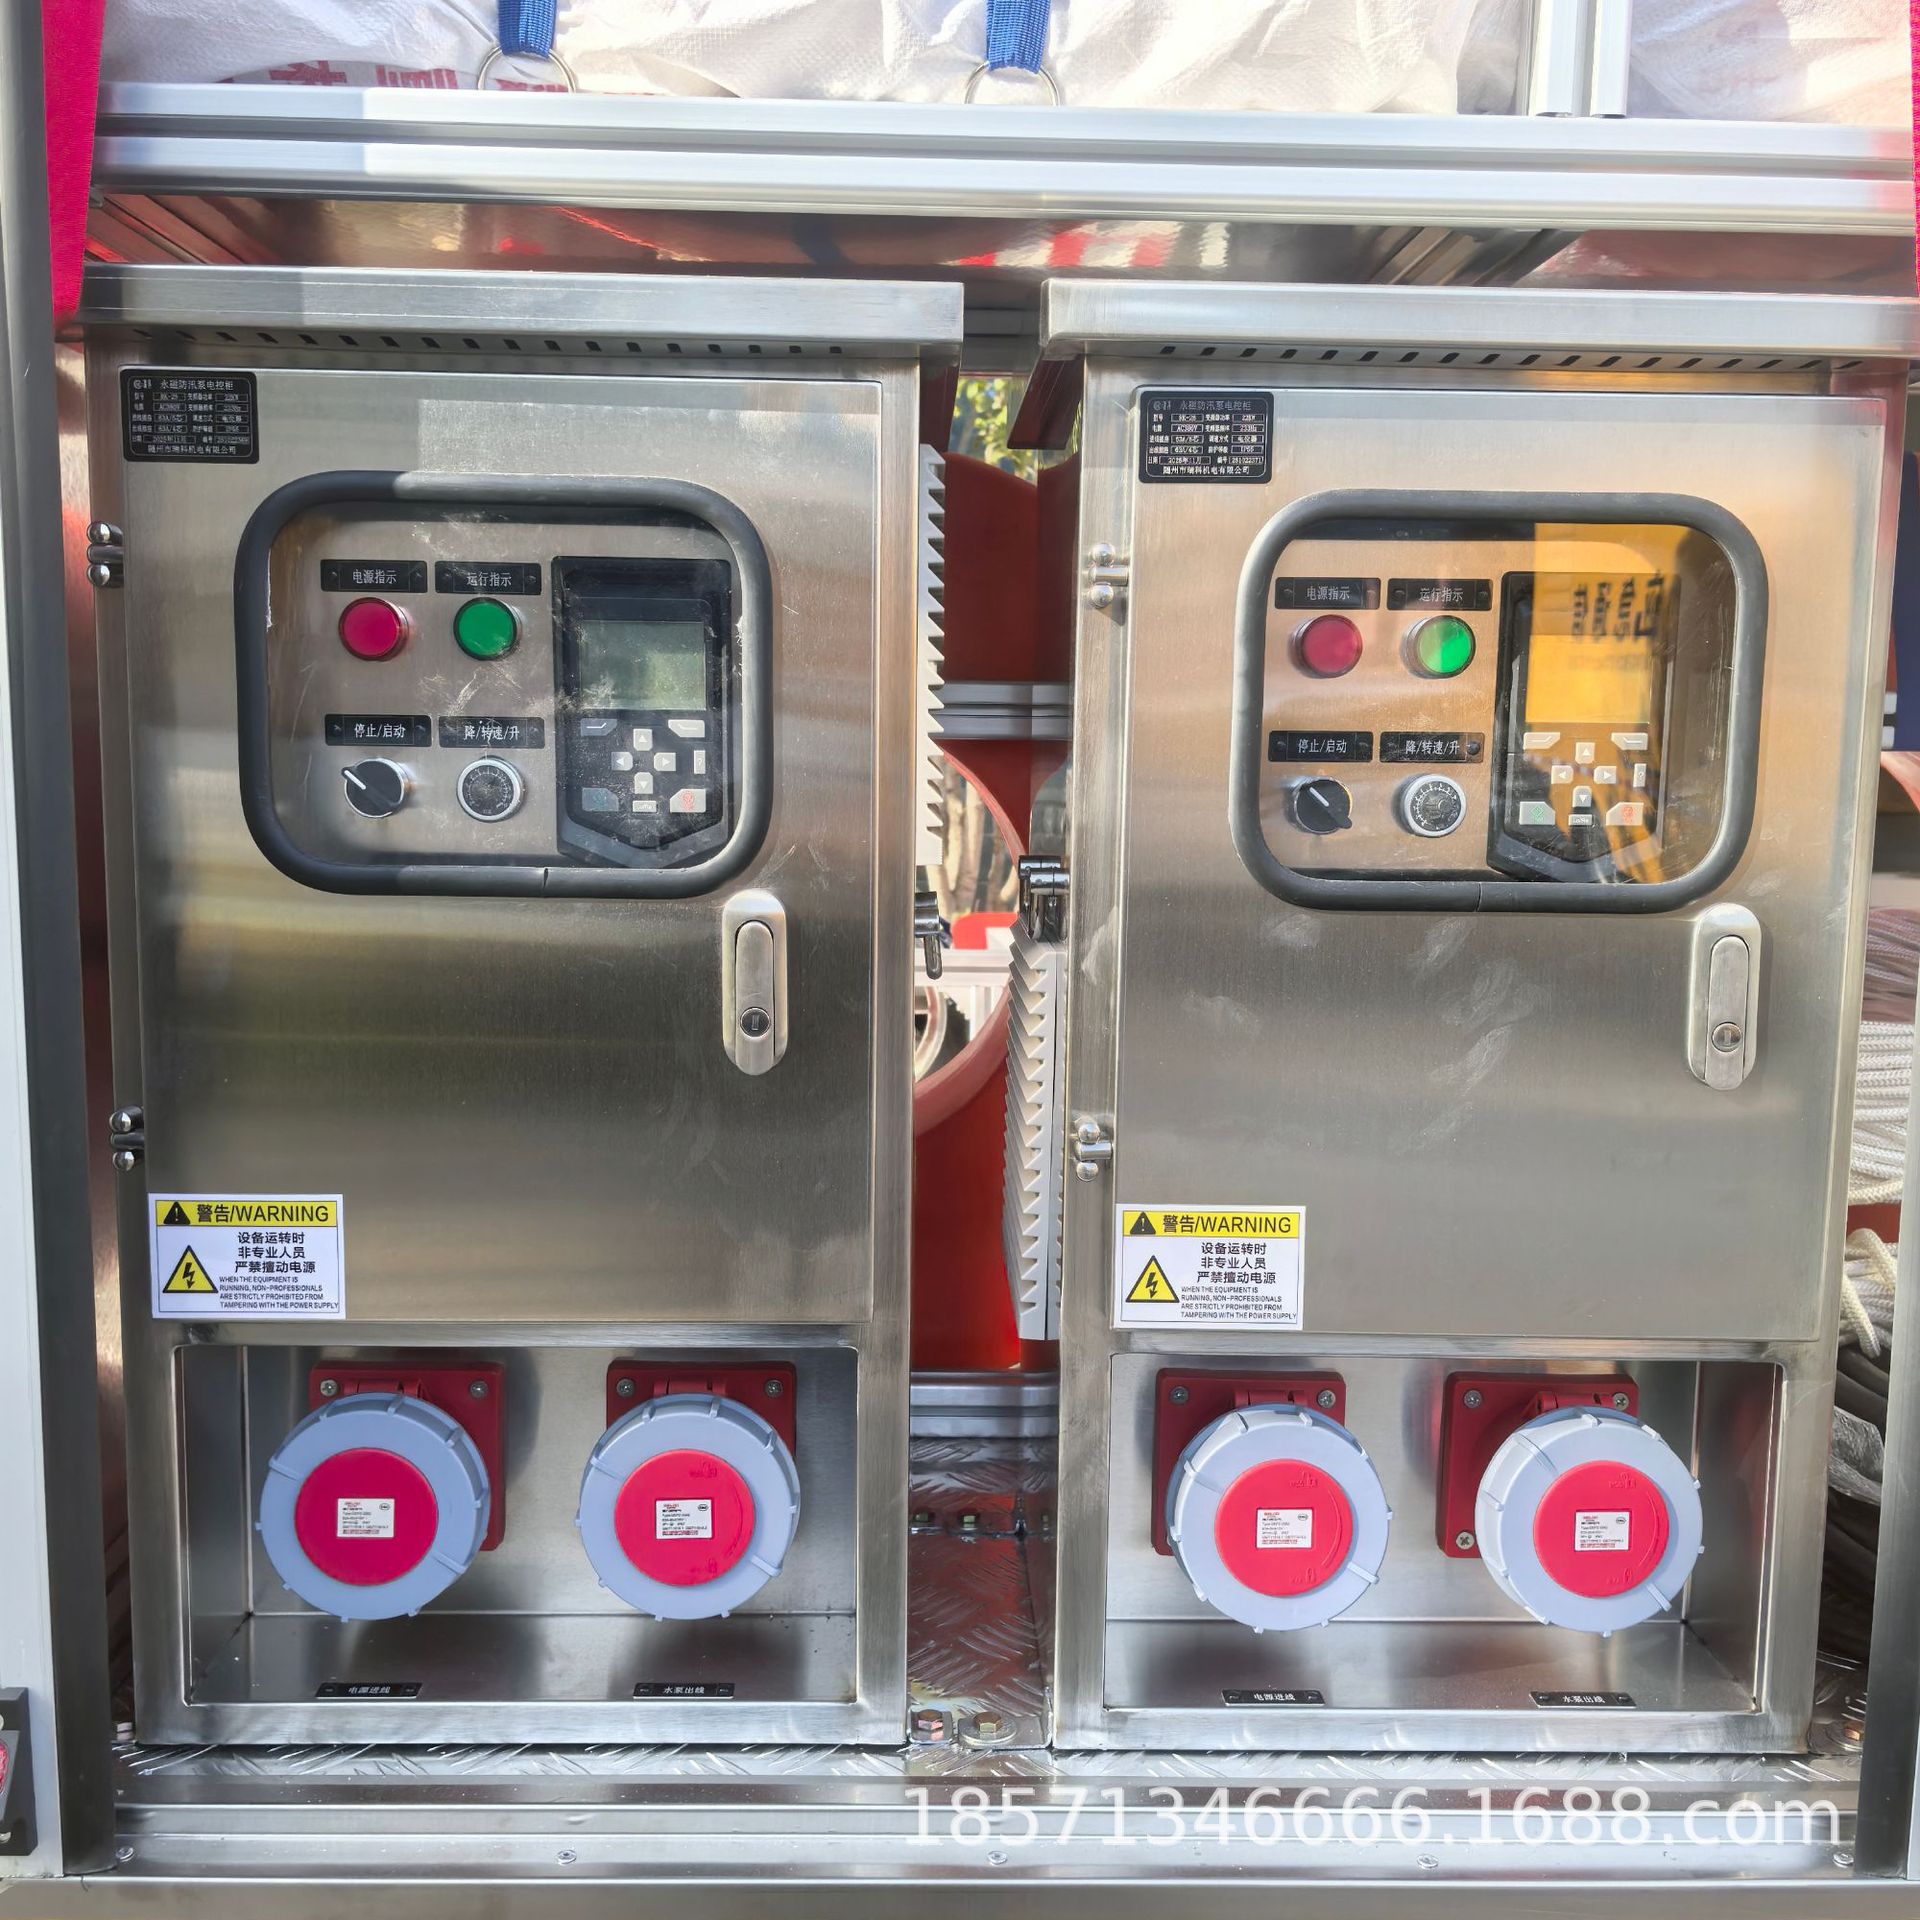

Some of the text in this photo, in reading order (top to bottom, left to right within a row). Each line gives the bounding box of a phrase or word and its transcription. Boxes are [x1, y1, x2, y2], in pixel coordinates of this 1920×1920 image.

[161, 379, 234, 390] 永磁防汛泵电控柜
[1180, 401, 1251, 410] 永磁防汛泵电控柜
[353, 570, 397, 583] 电源指示
[466, 572, 511, 587] 运行指示
[1307, 587, 1350, 600] 电源指示
[1419, 588, 1463, 602] 运行指示
[355, 724, 406, 738] 停止/启动
[464, 725, 520, 741] 降/转速/升
[1298, 739, 1347, 753] 停止/启动
[1405, 740, 1460, 754] 降/转速/升
[197, 1204, 329, 1223] 警告/WARNING
[1163, 1215, 1291, 1233] 警告/WARNING
[238, 1232, 305, 1244] 设备运转时
[238, 1247, 305, 1259] 非专业人员
[1201, 1242, 1267, 1255] 设备运转时
[235, 1261, 316, 1273] 严禁擅动电源
[1201, 1257, 1266, 1269] 非专业人员
[1197, 1271, 1276, 1284] 严禁擅动电源
[348, 1686, 391, 1694] 电源进线
[664, 1686, 705, 1694] 水泵出线
[1253, 1693, 1295, 1701] 电源进线
[1563, 1695, 1605, 1704] 水泵出线
